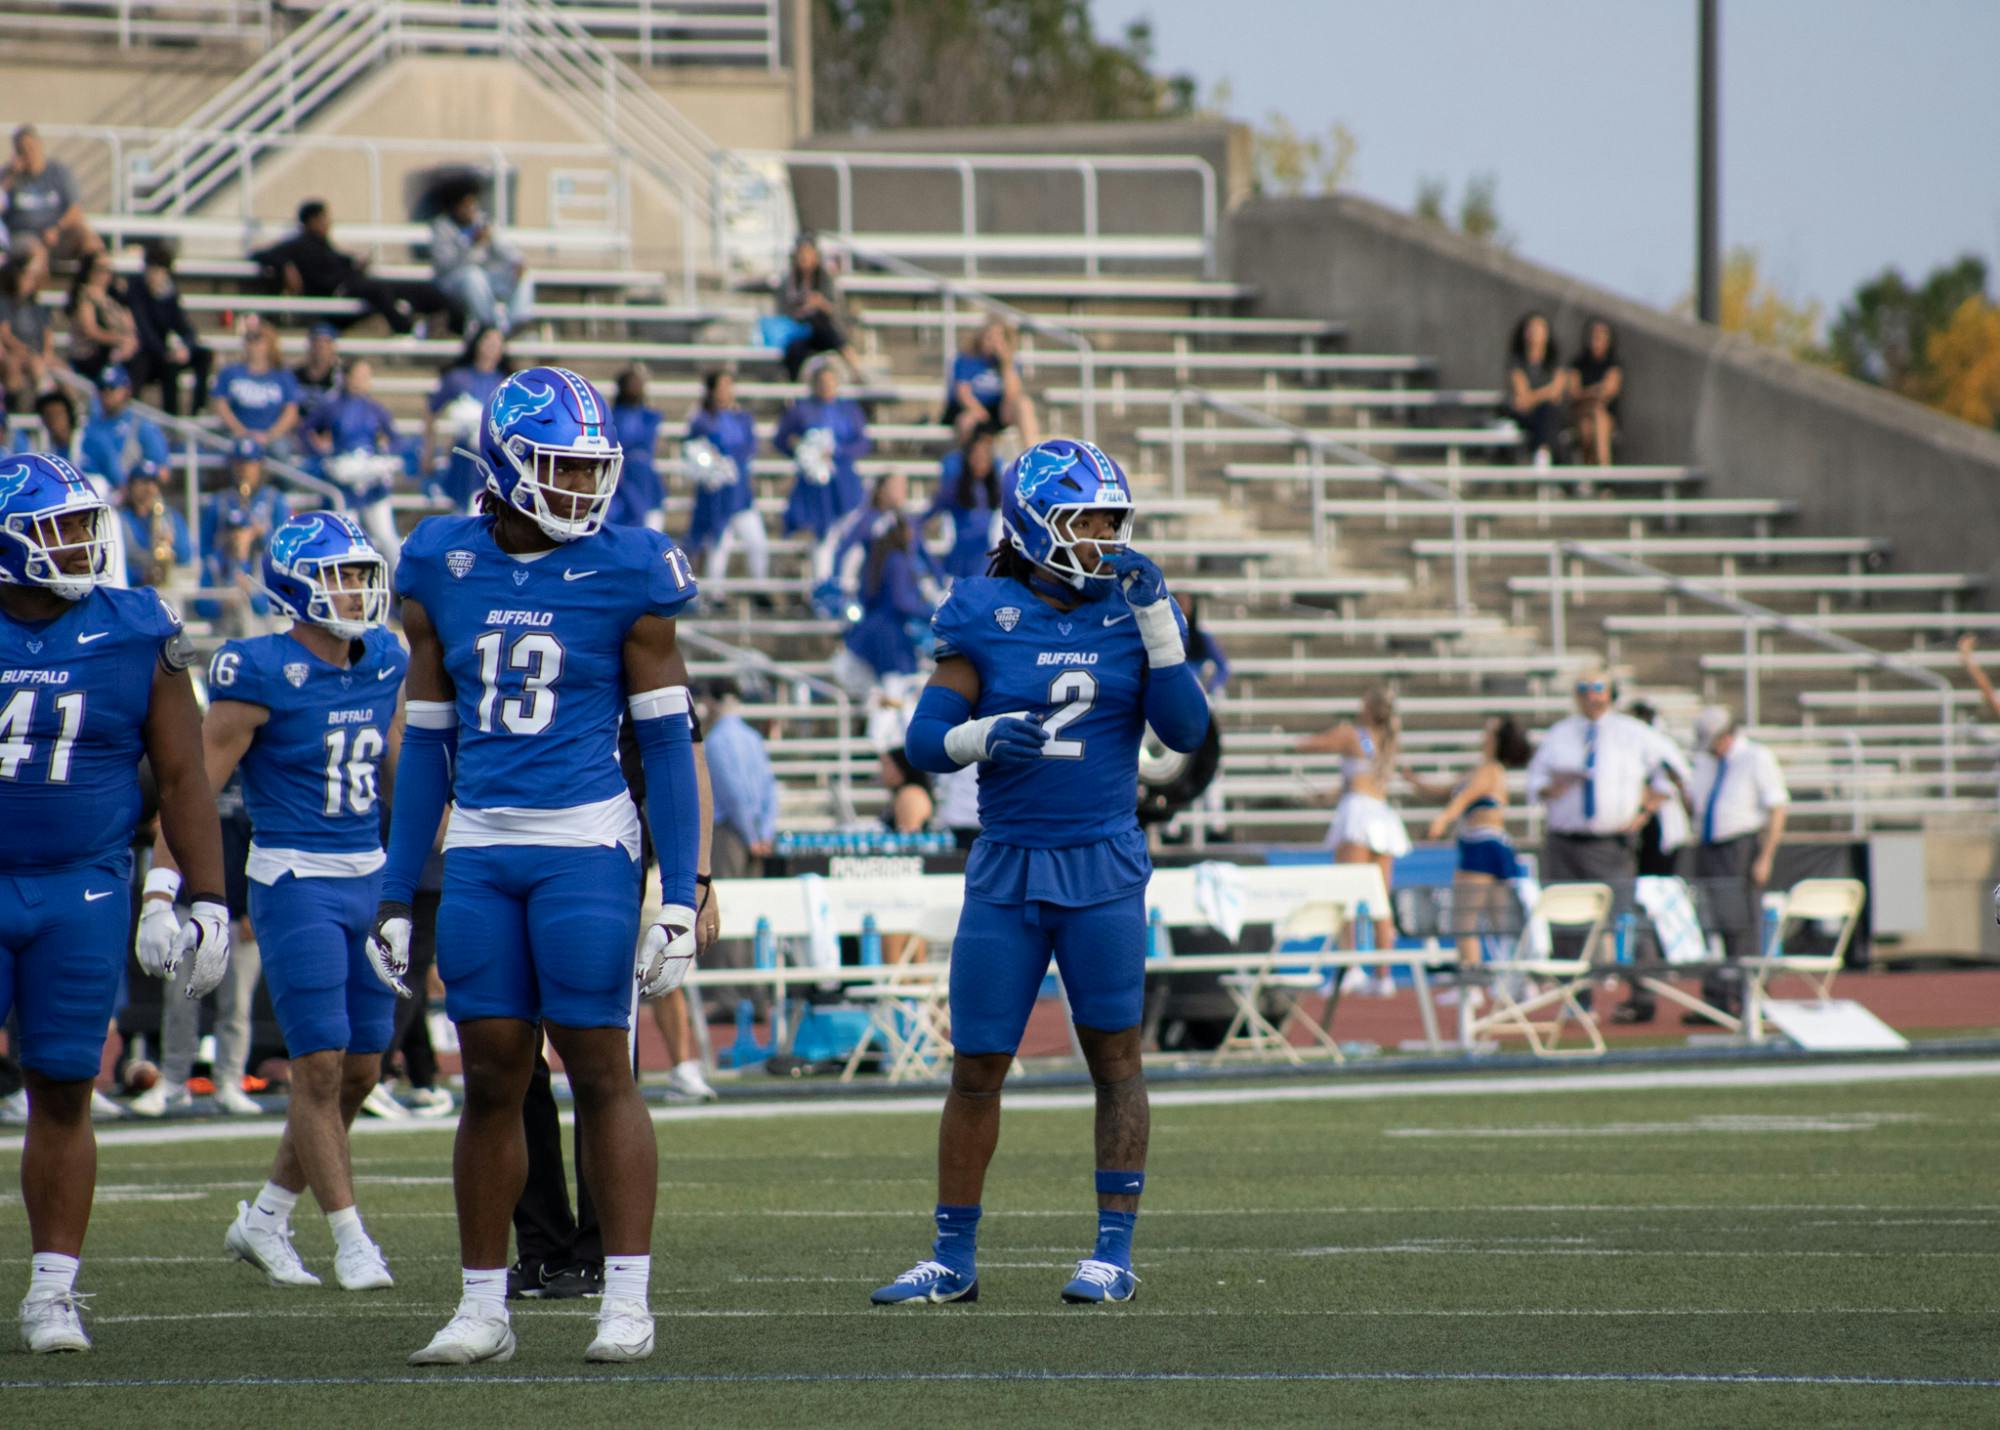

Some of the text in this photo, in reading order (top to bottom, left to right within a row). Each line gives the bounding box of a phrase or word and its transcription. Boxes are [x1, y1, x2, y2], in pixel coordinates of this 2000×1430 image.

[486, 610, 554, 626] BUFFALO
[0, 670, 70, 684] BUFFALO
[475, 629, 565, 735] 13
[1036, 652, 1099, 666] BUFFALO
[0, 688, 87, 785] 41
[328, 708, 374, 724] BUFFALO
[1039, 668, 1099, 760] 2
[324, 724, 385, 817] 16
